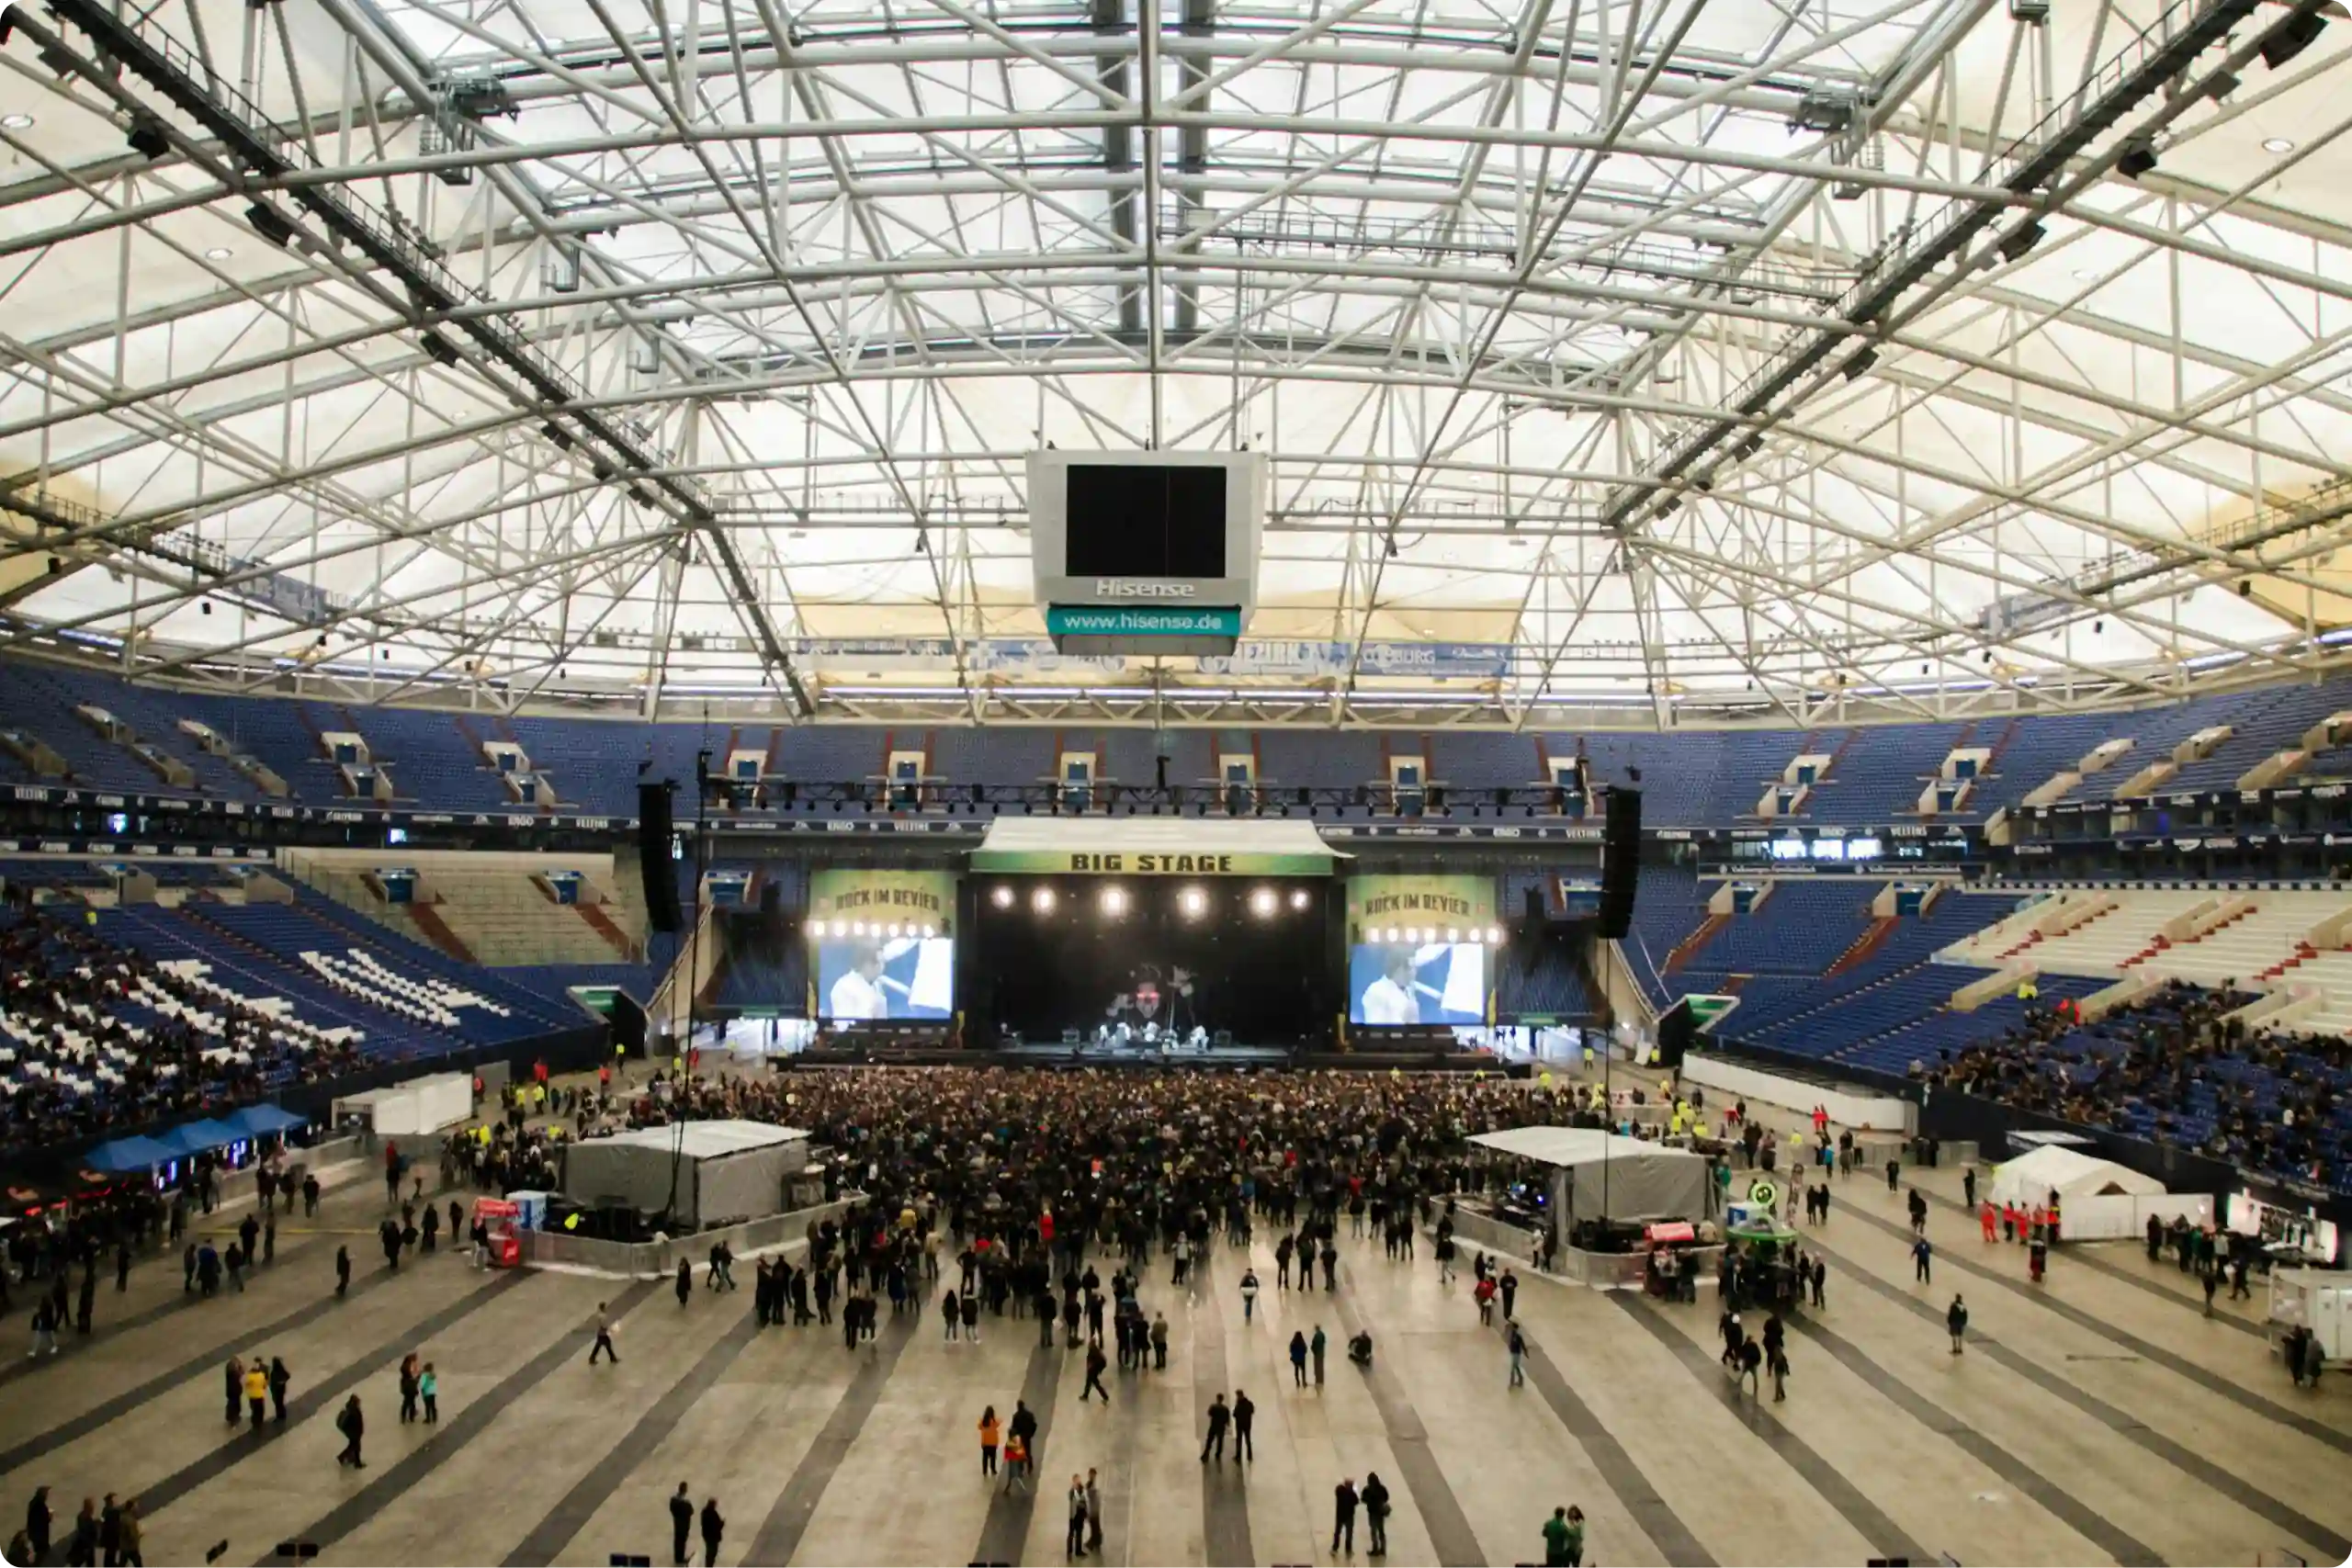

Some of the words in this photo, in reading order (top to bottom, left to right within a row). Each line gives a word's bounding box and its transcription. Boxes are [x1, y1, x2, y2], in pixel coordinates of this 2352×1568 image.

[1096, 580, 1195, 597] Hisense
[1064, 613, 1223, 630] www.hisense.de
[1070, 853, 1123, 872] BIG
[1136, 854, 1232, 873] STAGE
[874, 887, 889, 906] IM
[1404, 893, 1419, 909] IM
